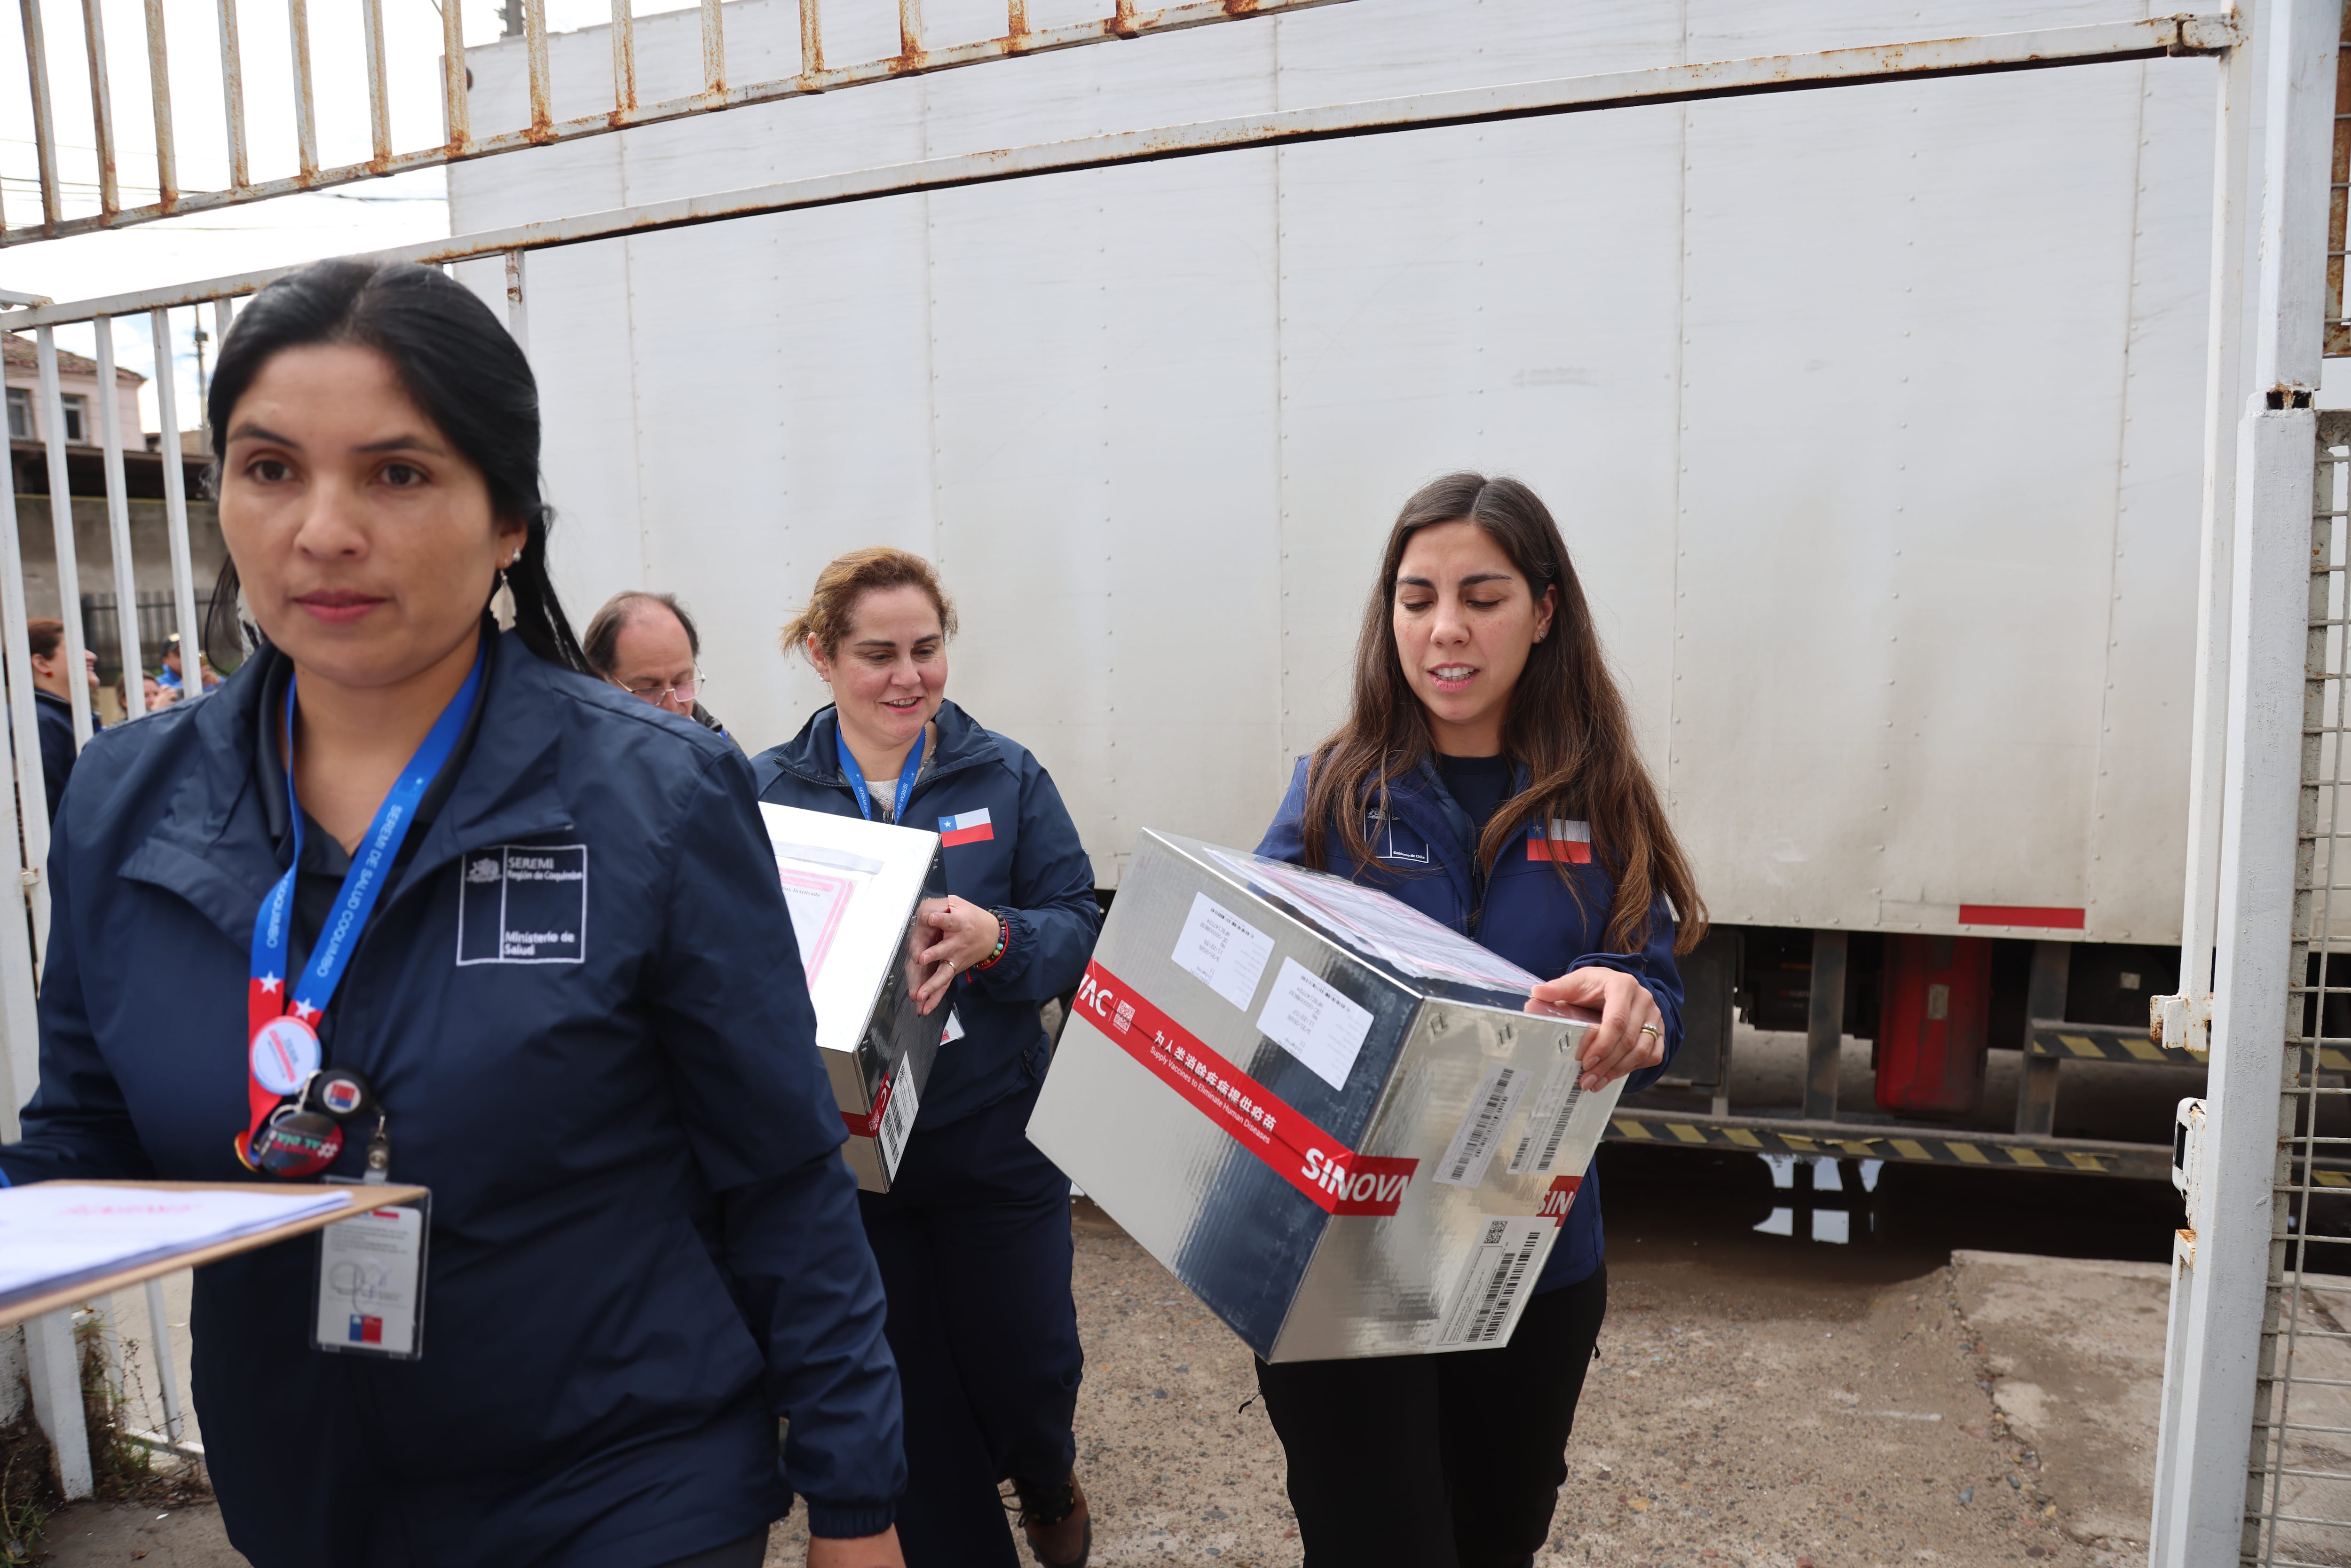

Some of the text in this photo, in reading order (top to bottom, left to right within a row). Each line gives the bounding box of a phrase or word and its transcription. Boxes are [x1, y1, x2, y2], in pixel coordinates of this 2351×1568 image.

[858, 787, 867, 805] SEREMI
[899, 783, 908, 802] SEREMI
[897, 803, 902, 812] DE
[508, 856, 554, 869] SEREMI
[507, 870, 583, 882] Región de Coquimbo
[316, 804, 402, 977] SEREMI DE SALUD COQUIMBO
[793, 888, 820, 897] Inactivada
[504, 930, 575, 944] Ministerio de
[504, 944, 535, 955] Salud
[1154, 1030, 1277, 1133] 为人类消除疾病提供疫苗
[1150, 1046, 1271, 1144] Supply Vaccines to Eliminate Human Diseases
